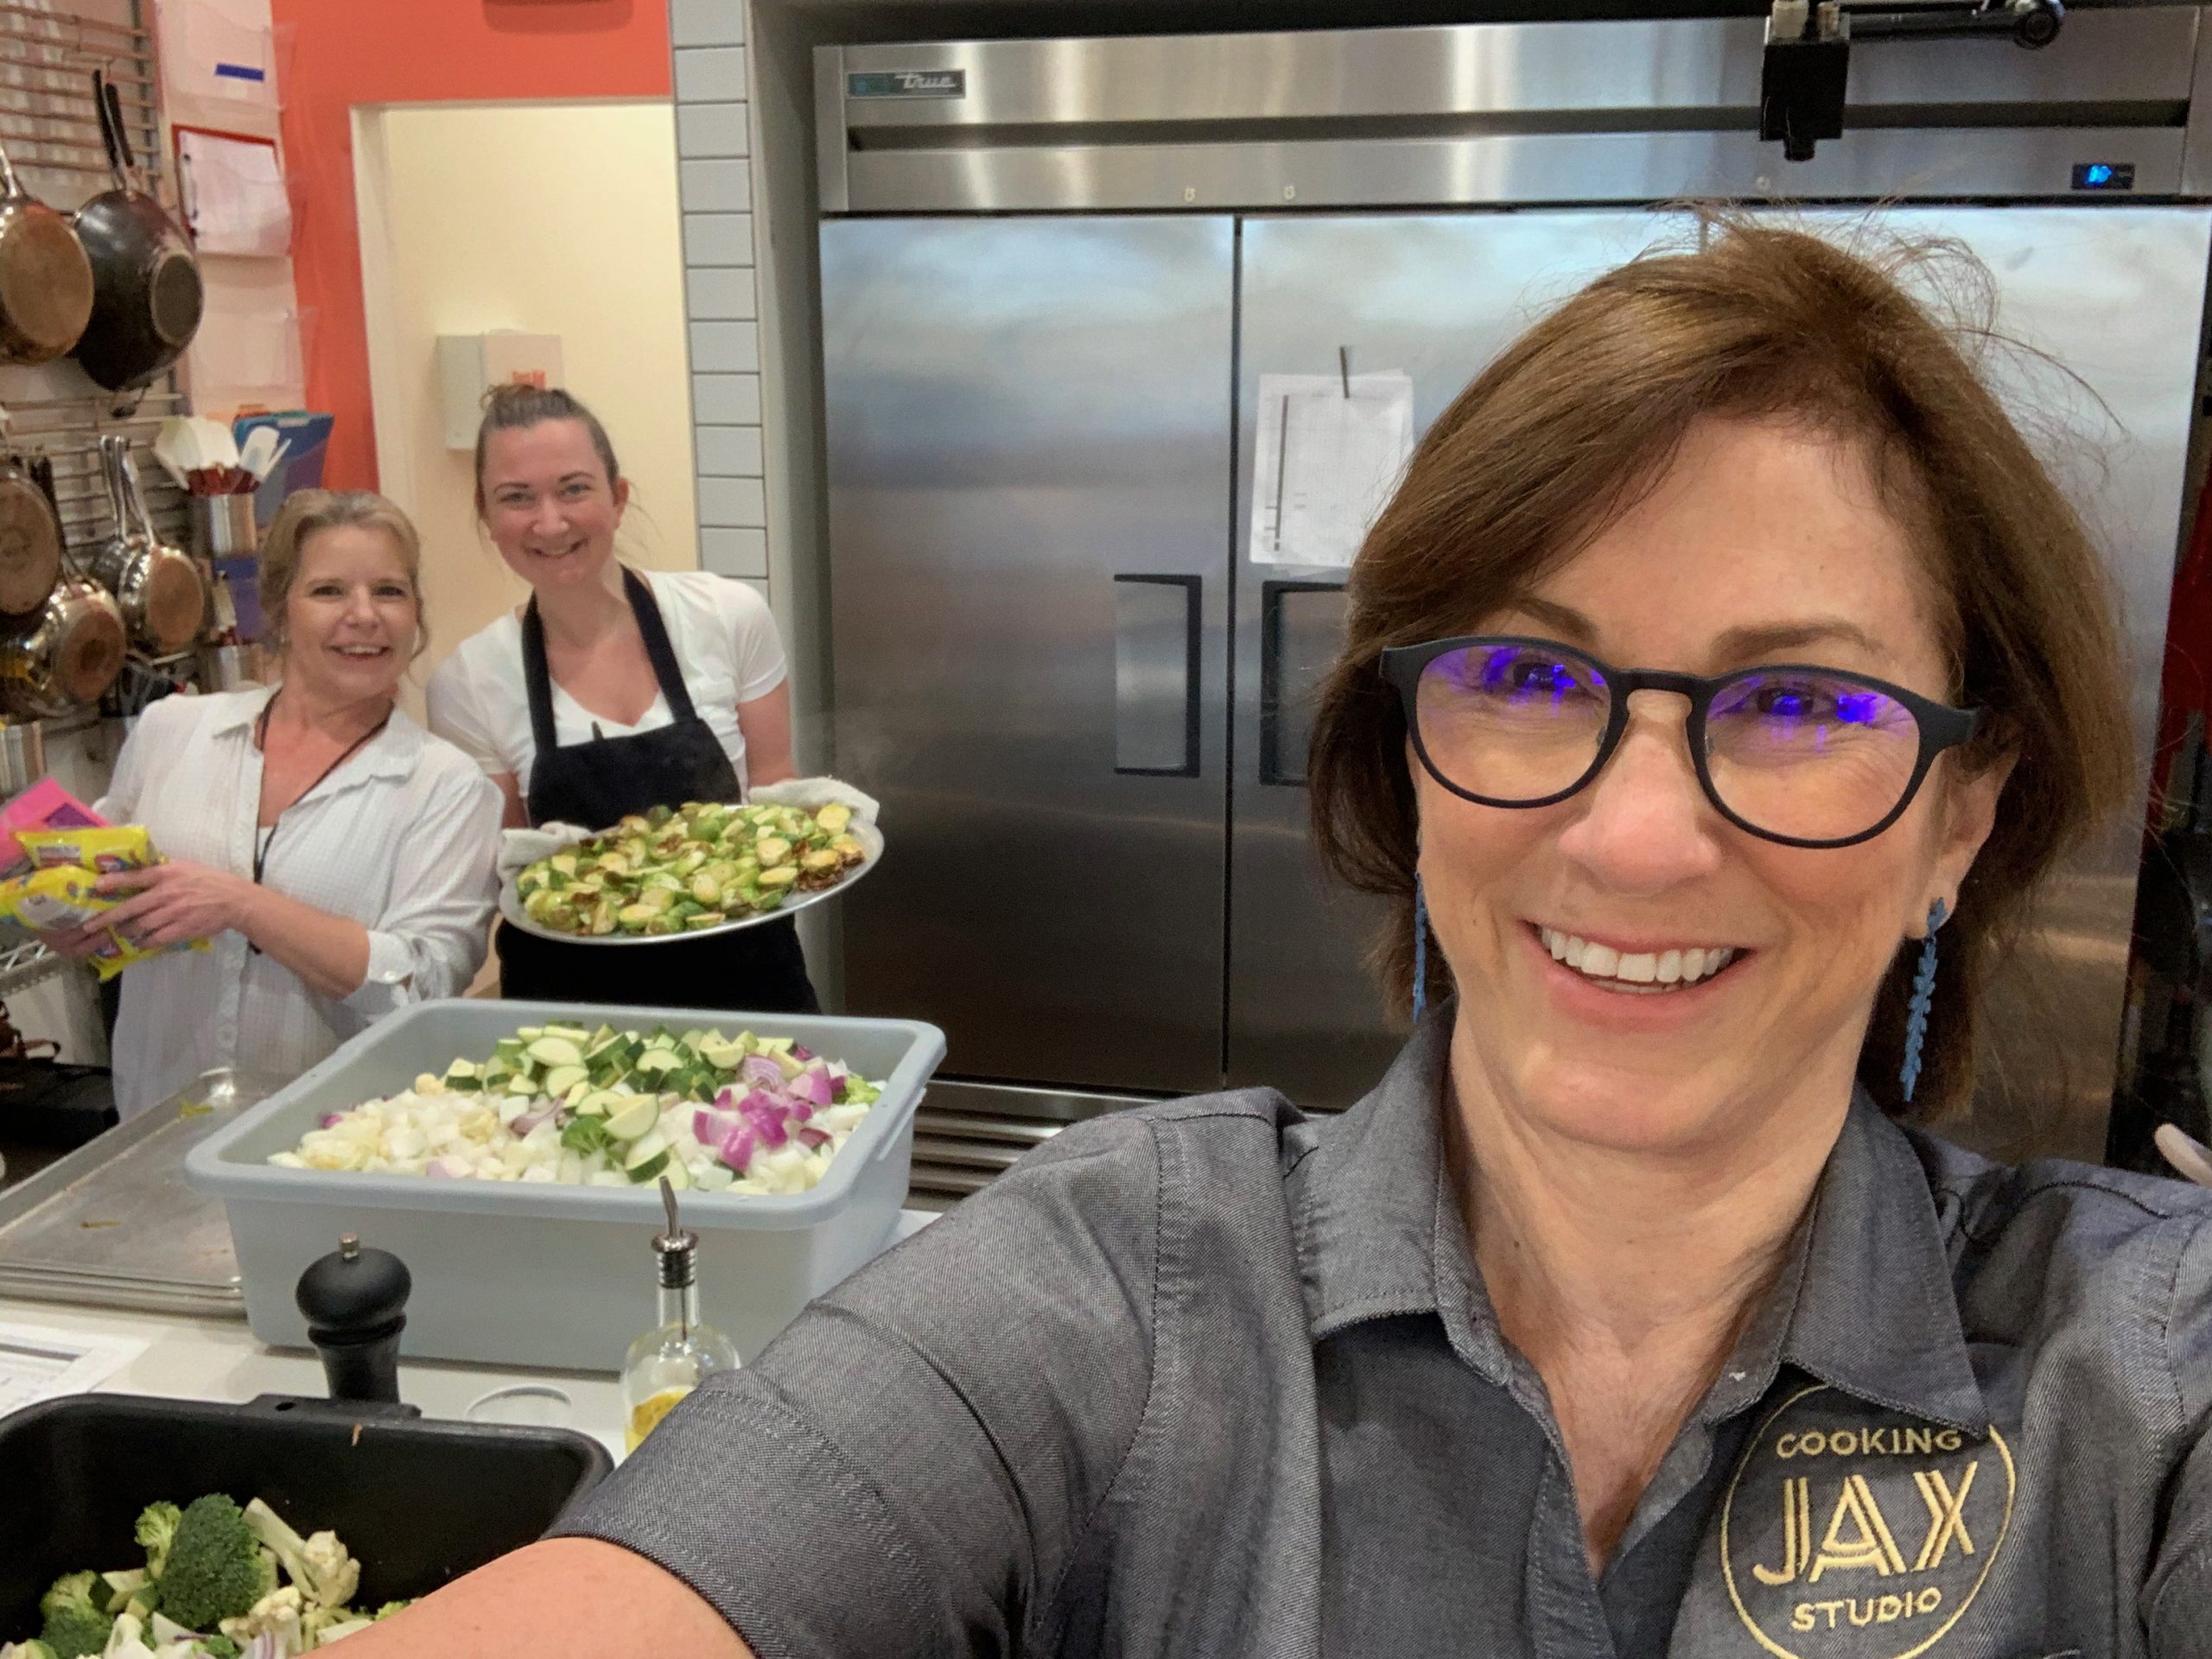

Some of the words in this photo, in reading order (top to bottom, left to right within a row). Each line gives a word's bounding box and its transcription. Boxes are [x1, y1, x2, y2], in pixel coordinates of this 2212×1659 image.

[1776, 1427, 1962, 1459] COOKING
[1752, 1460, 1978, 1586] JAX
[1790, 1586, 1942, 1631] STUDIO
